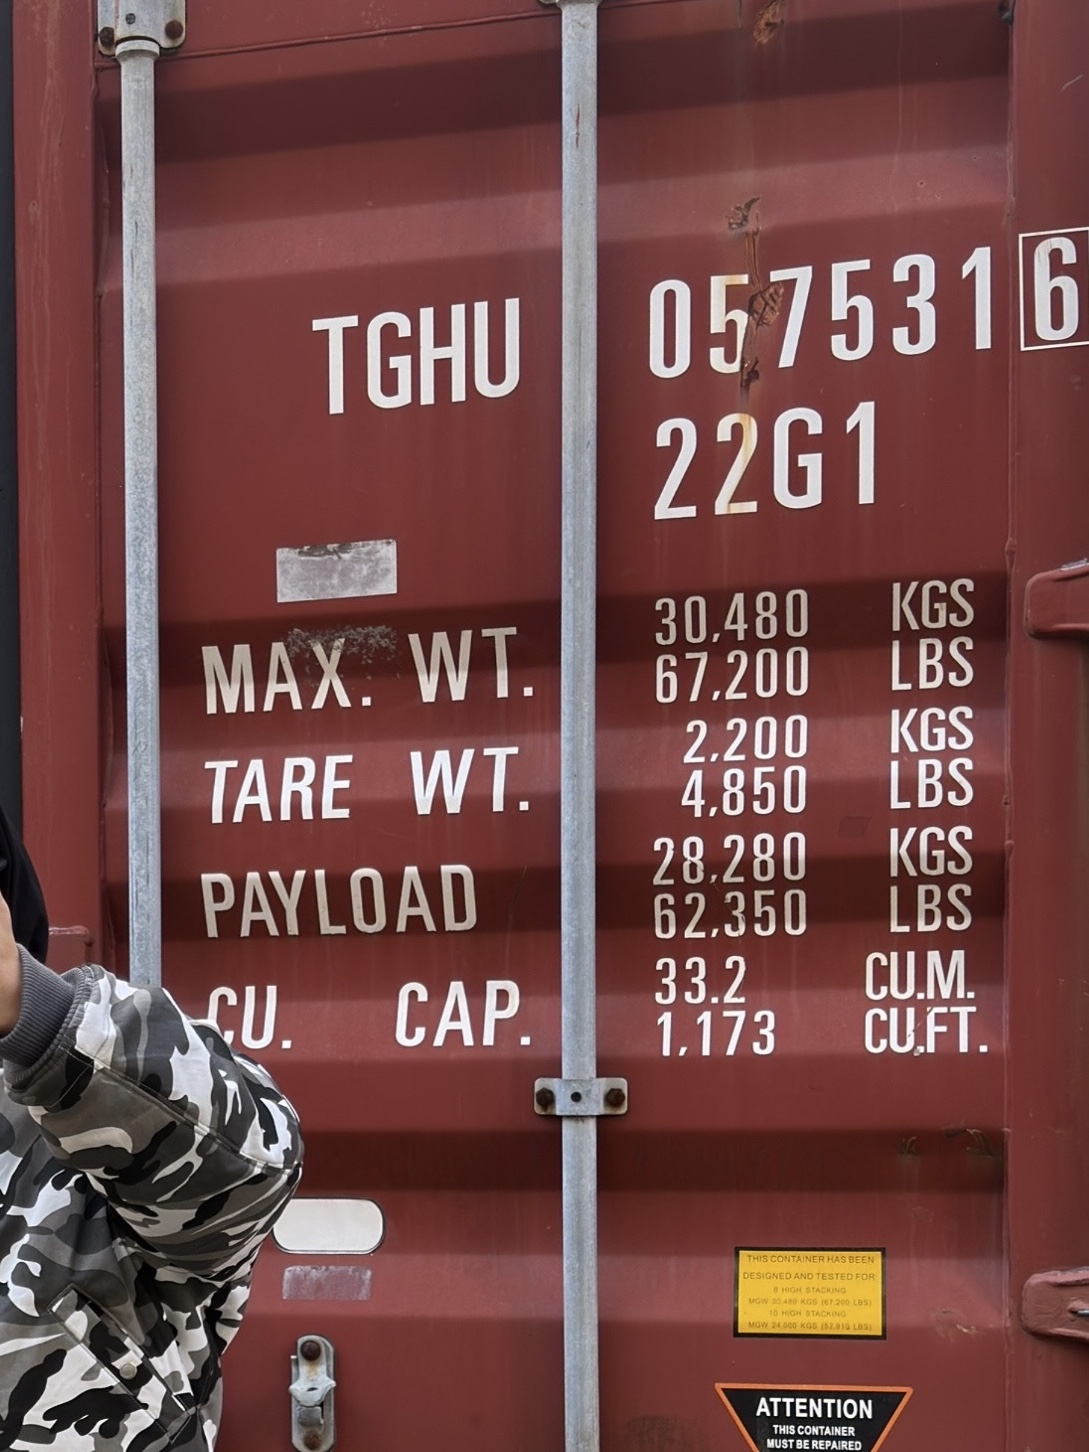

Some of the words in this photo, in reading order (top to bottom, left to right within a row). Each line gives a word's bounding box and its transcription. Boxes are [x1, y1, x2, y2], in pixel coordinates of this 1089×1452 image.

[313, 298, 520, 415] TGHU
[650, 247, 992, 379] 057531
[1034, 237, 1079, 340] 6
[655, 401, 875, 520] 22G1
[202, 637, 373, 714] MAX.
[408, 627, 534, 702] WT.
[655, 588, 809, 645] 30,480
[892, 578, 975, 632] KGS
[655, 645, 809, 703] 67,200
[891, 637, 974, 691] LBS
[205, 754, 353, 824] TARE
[410, 746, 530, 814] WT.
[683, 715, 808, 766] 2,200
[890, 705, 974, 753] KGS
[681, 764, 807, 817] 4,850
[890, 757, 974, 809] LBS
[200, 863, 477, 938] PAYLOAD
[654, 831, 806, 885] 28,280
[890, 825, 973, 877] KGS
[654, 889, 807, 940] 62,350
[890, 883, 973, 932] LBS
[207, 985, 292, 1050] CU.
[396, 980, 531, 1047] CAP.
[655, 955, 747, 1005] 33.2
[865, 949, 976, 1000] CU.M.
[658, 1009, 775, 1057] 1,173
[864, 1006, 989, 1055] CU.FT.
[742, 1271, 792, 1280] DESIGNED
[793, 1272, 814, 1280] AND
[816, 1272, 853, 1281] TESTED
[855, 1273, 876, 1281] FOR
[747, 1254, 768, 1263] THIS
[770, 1254, 825, 1264] CONTAINER
[827, 1255, 847, 1264] HAS
[848, 1255, 875, 1264] BEEN
[748, 1297, 769, 1306] MGW
[781, 1286, 802, 1294] HIGH
[805, 1286, 847, 1295] STACKING
[781, 1309, 802, 1318] HIGH
[805, 1309, 847, 1318] STACKING
[748, 1321, 769, 1329] MGW
[756, 1397, 873, 1419] ATTENTION
[773, 1424, 796, 1435] THIS
[797, 1425, 855, 1437] CONTAINER
[767, 1439, 794, 1449] MUST
[796, 1439, 810, 1449] BE
[812, 1440, 862, 1451] REPAIRED
